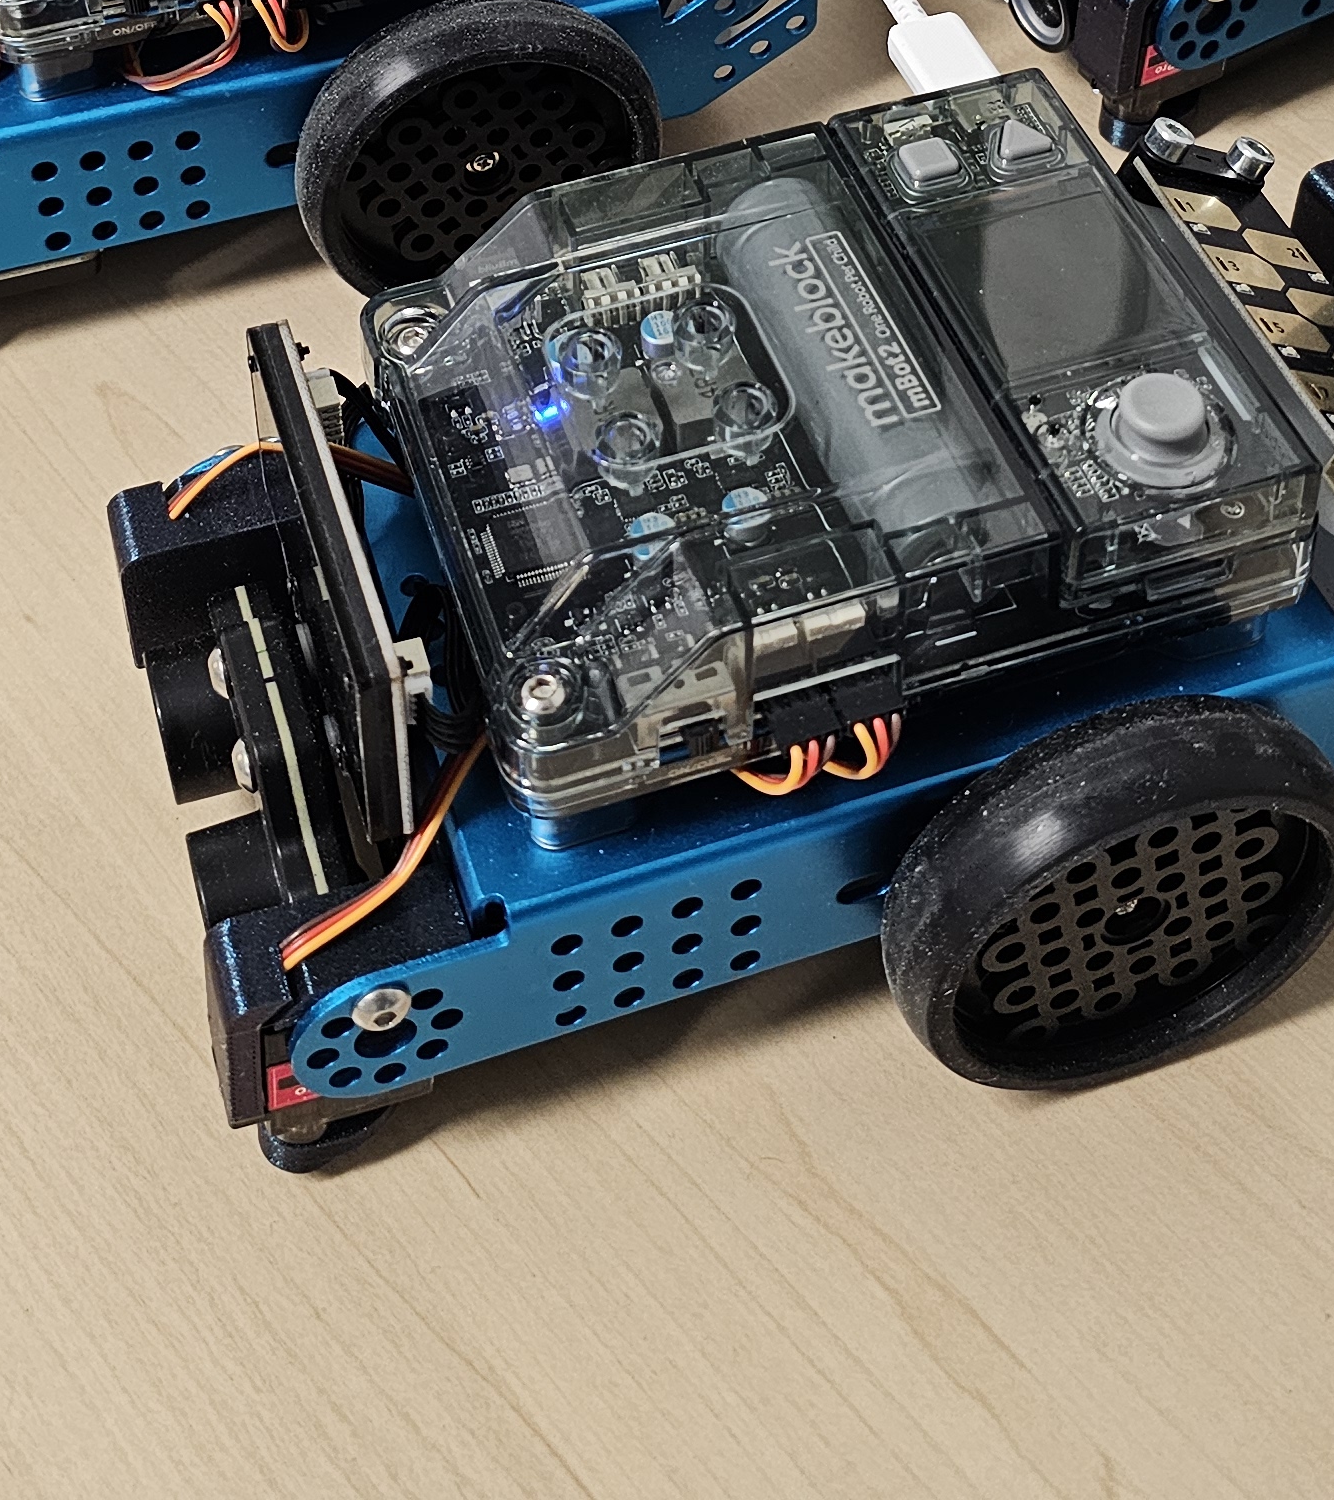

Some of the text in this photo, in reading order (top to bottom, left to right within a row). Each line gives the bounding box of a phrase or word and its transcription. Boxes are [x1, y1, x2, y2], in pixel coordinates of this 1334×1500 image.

[112, 20, 157, 36] ON/OFF
[851, 282, 878, 315] Robot
[767, 241, 901, 428] makeblock
[870, 313, 891, 339] One
[877, 341, 932, 408] mBot2
